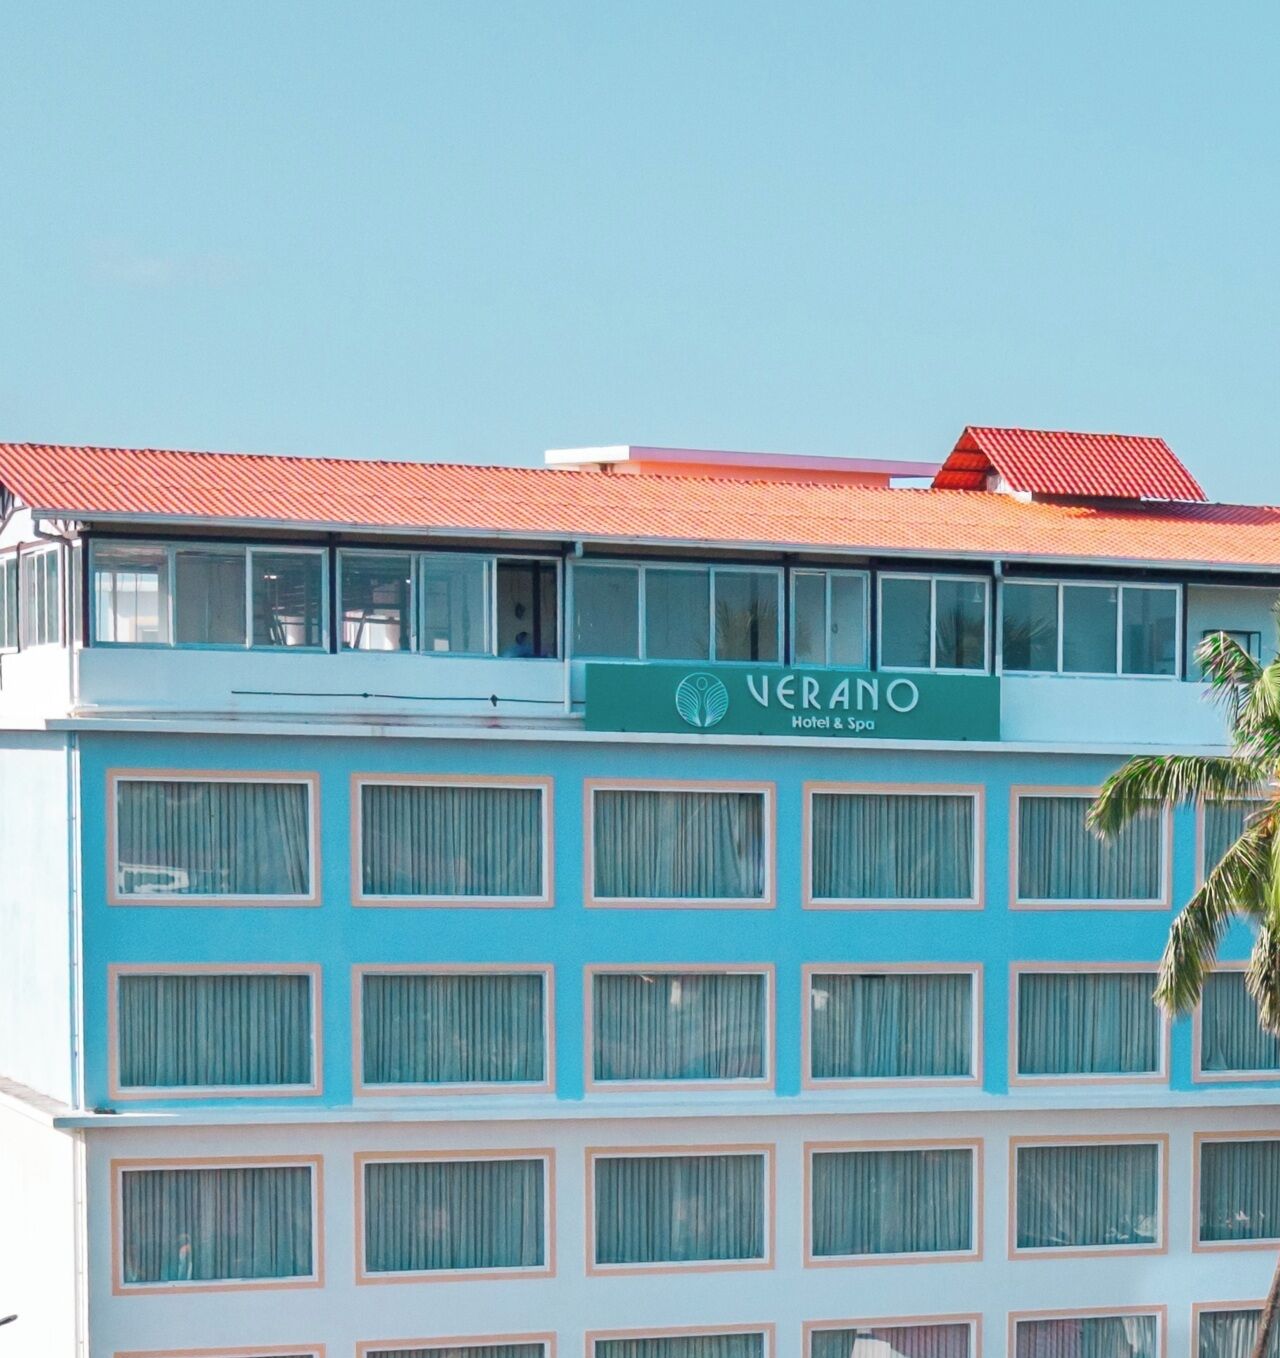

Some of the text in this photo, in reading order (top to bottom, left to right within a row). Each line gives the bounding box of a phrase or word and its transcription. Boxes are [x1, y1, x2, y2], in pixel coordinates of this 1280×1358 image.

[746, 674, 919, 713] VERANO
[791, 715, 875, 732] Hotel & Spa
